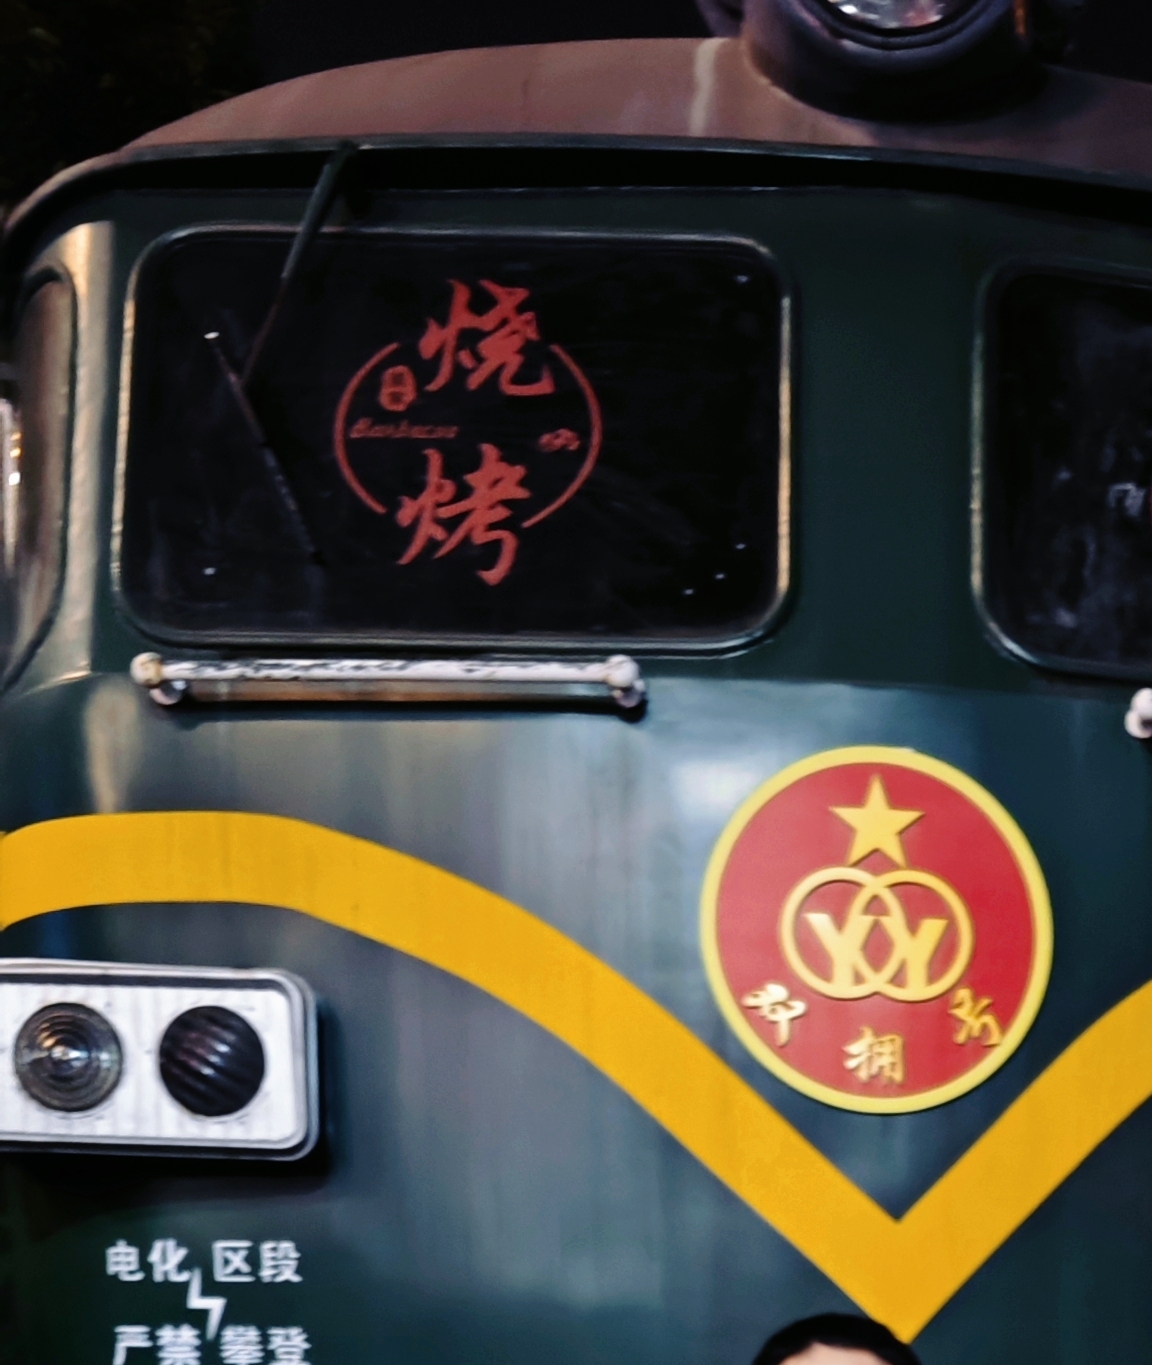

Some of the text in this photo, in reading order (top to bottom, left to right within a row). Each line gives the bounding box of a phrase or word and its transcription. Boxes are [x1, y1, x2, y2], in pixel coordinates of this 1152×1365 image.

[396, 279, 555, 587] 烧烤
[105, 1238, 303, 1282] 电化区段
